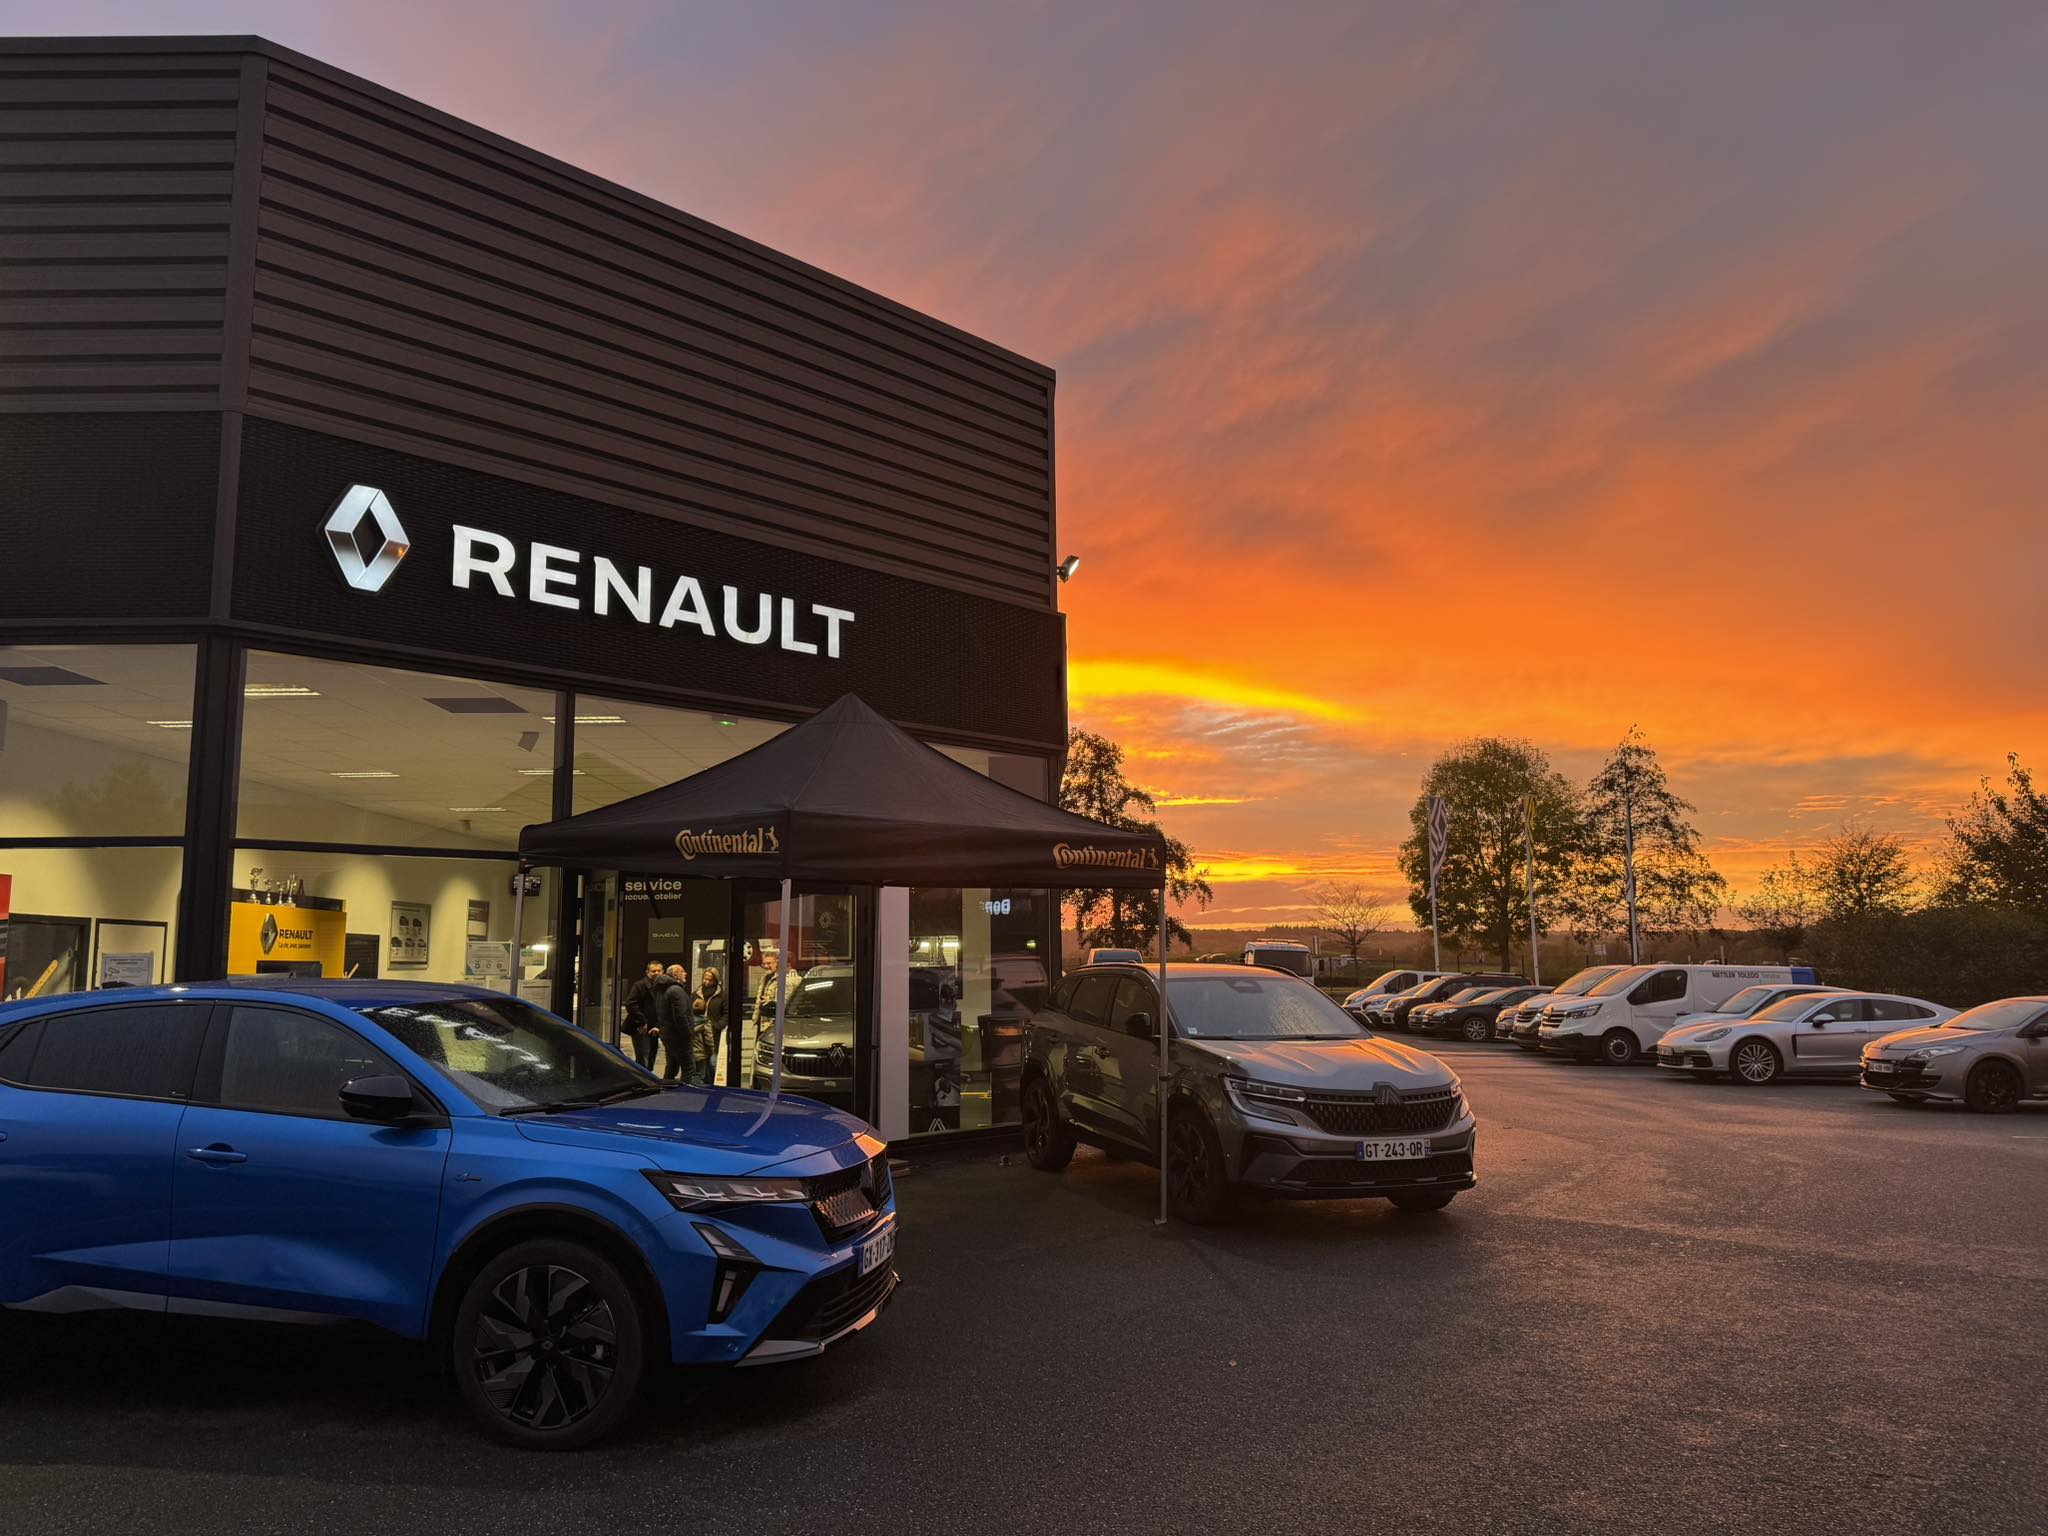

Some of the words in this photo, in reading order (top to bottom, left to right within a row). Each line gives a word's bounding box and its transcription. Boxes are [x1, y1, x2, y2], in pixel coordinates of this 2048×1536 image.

[452, 524, 855, 658] RENAULT
[675, 827, 764, 860] Continental
[1052, 843, 1147, 869] Continental
[654, 892, 682, 900] atelier
[279, 929, 313, 940] RENAULT
